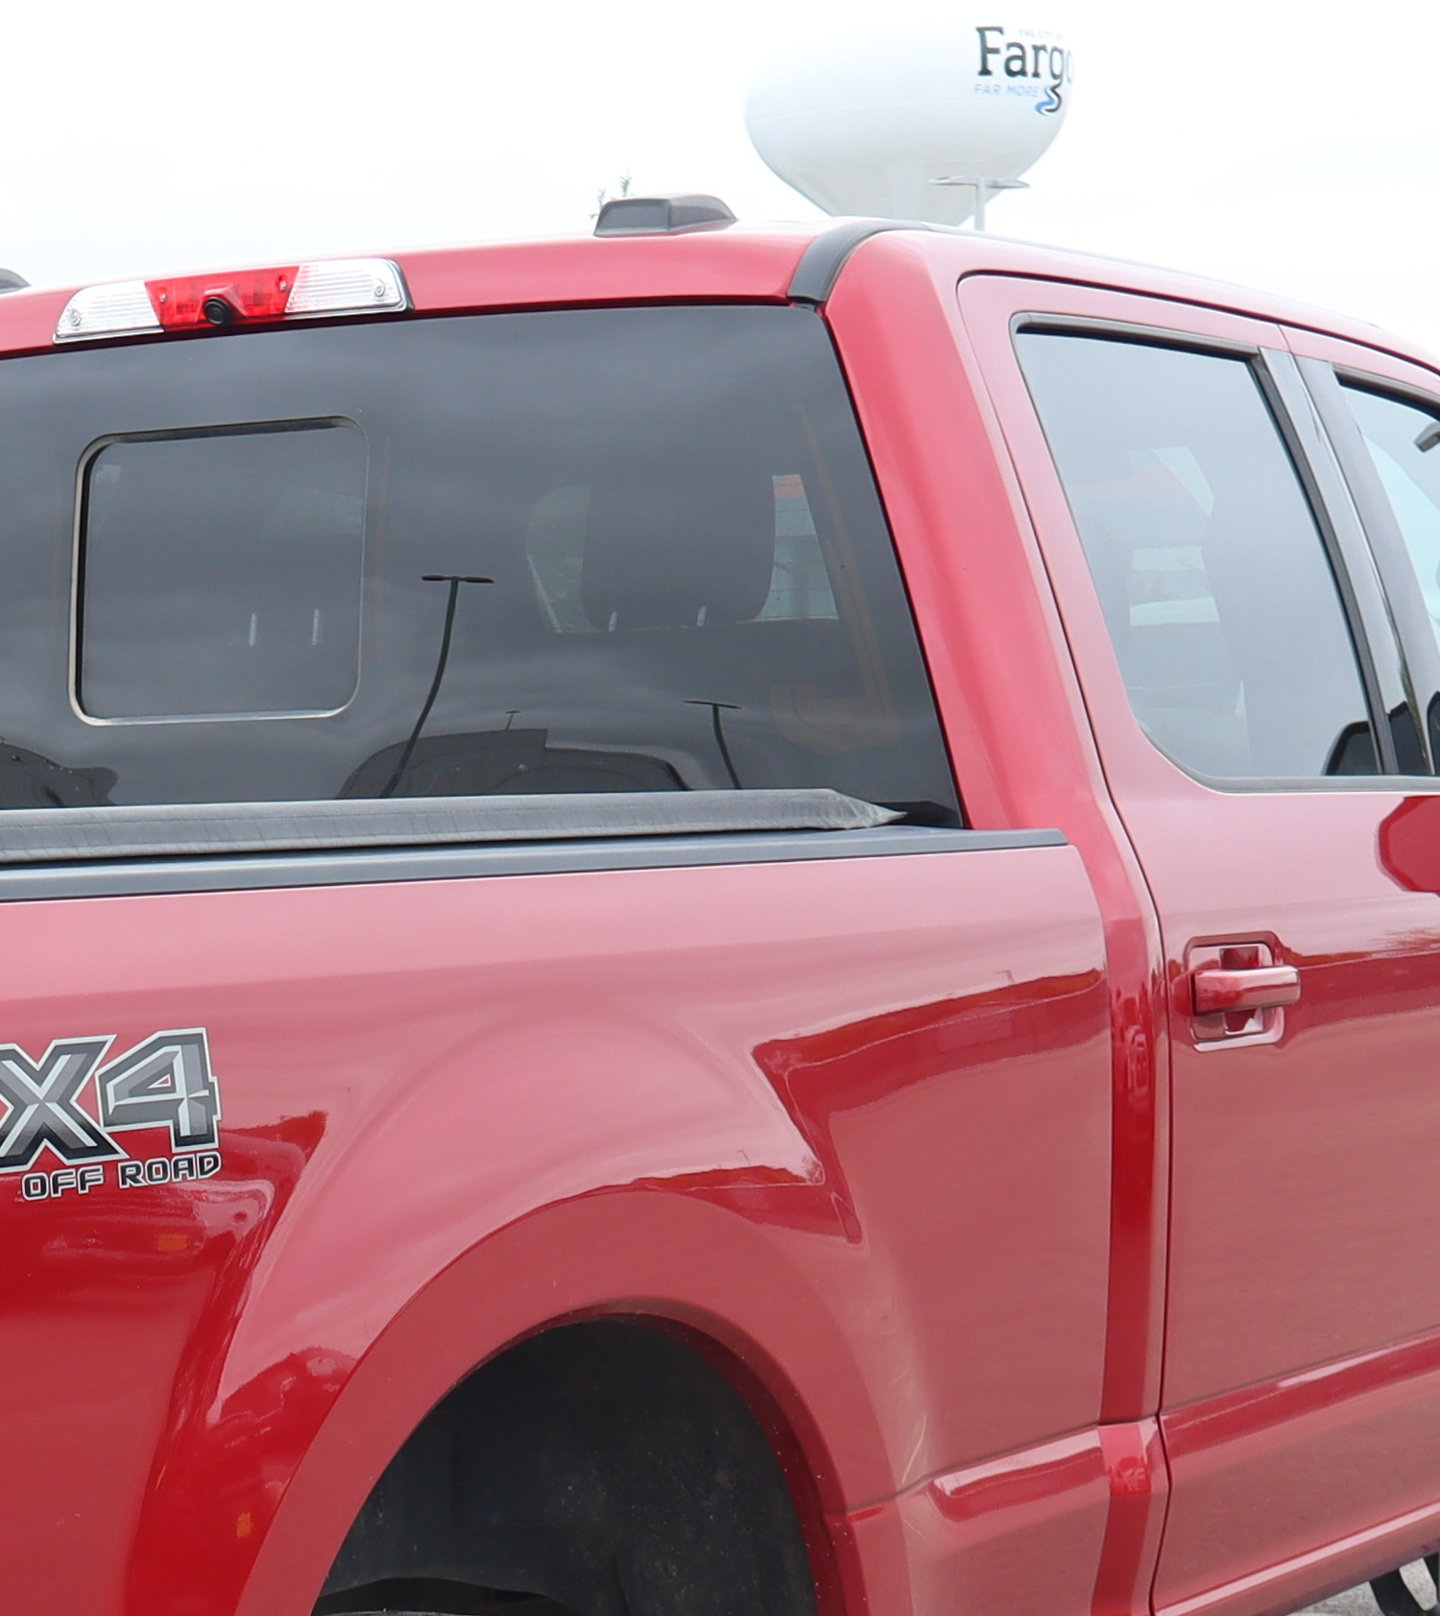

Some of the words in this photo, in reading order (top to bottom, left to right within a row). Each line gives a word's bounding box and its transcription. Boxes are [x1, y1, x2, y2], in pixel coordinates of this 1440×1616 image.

[975, 26, 1074, 112] Fargo
[975, 84, 1001, 95] FAR
[1007, 85, 1040, 98] MORE
[23, 1164, 105, 1201] OFF
[119, 1151, 221, 1189] ROAD
